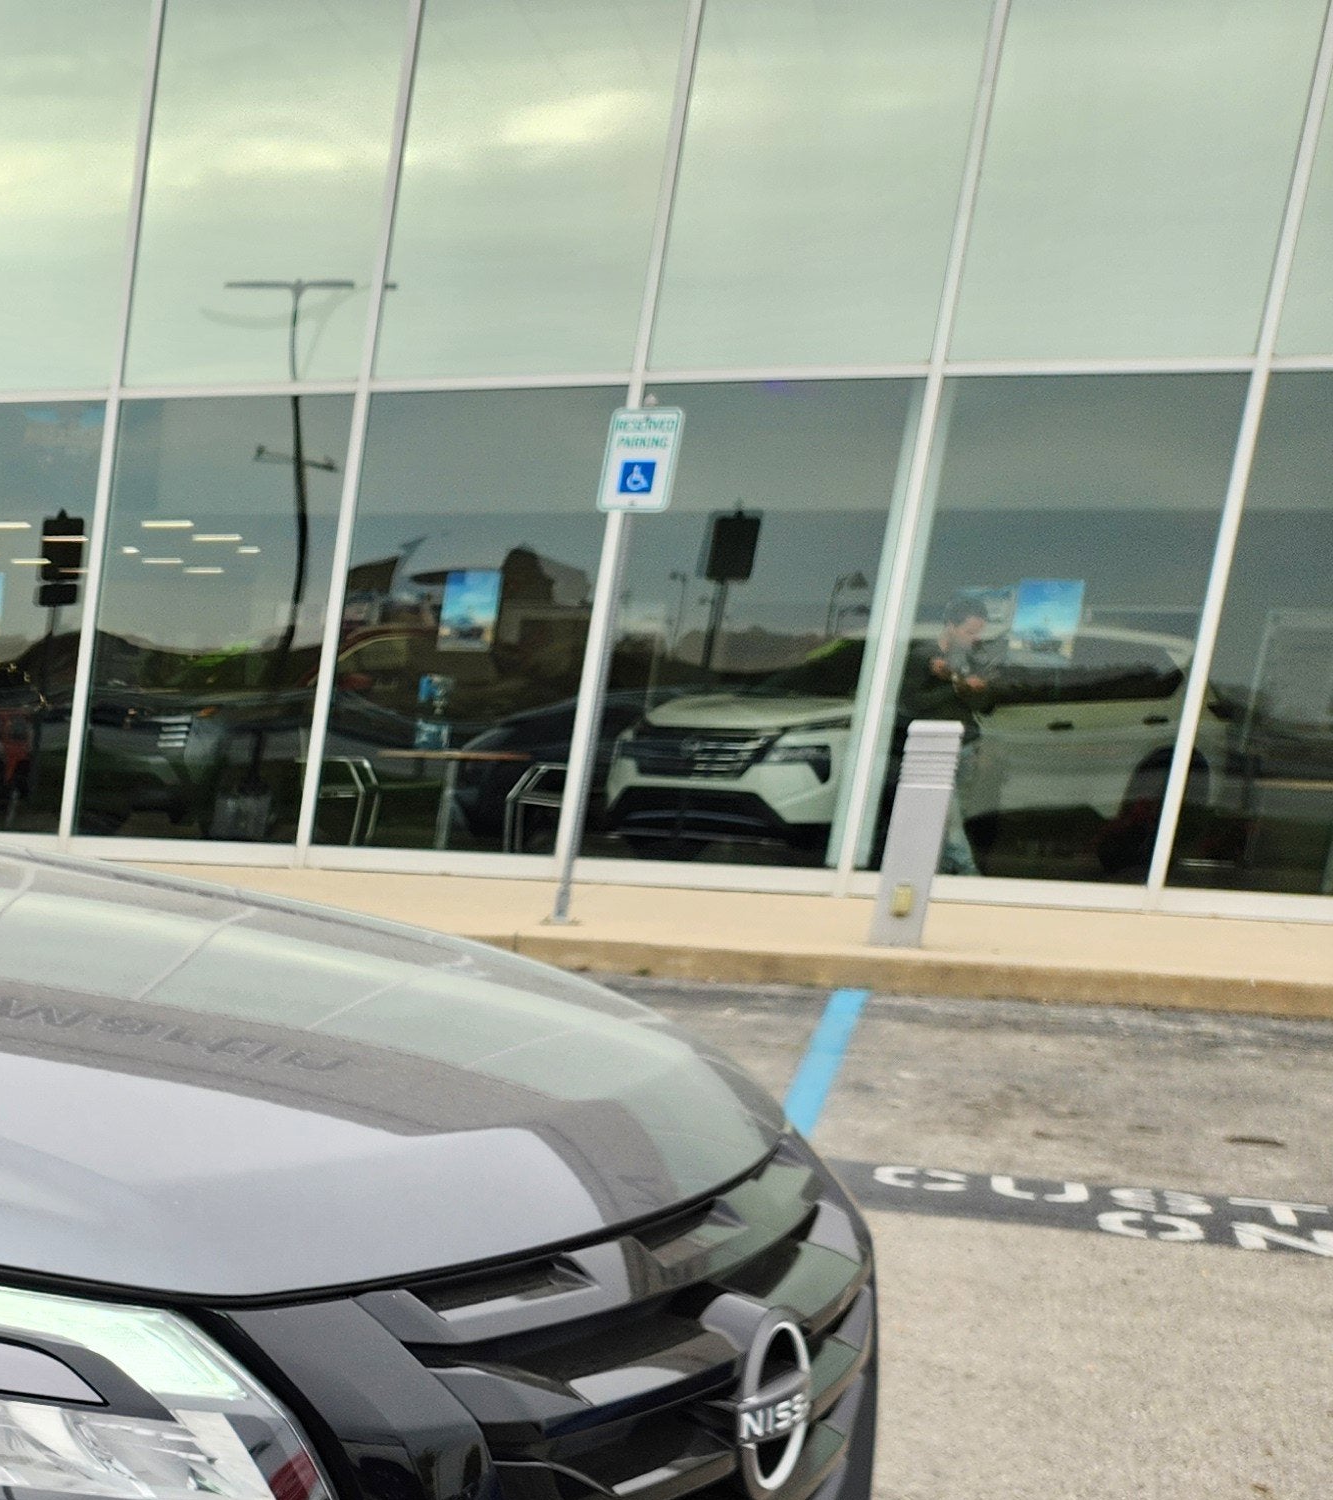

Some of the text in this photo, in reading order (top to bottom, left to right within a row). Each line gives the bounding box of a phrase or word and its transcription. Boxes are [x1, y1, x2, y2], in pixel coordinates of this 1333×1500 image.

[616, 418, 677, 431] RESERVED
[617, 436, 667, 447] PARKING
[873, 1166, 1330, 1227] CUST
[739, 1393, 807, 1440] NISS
